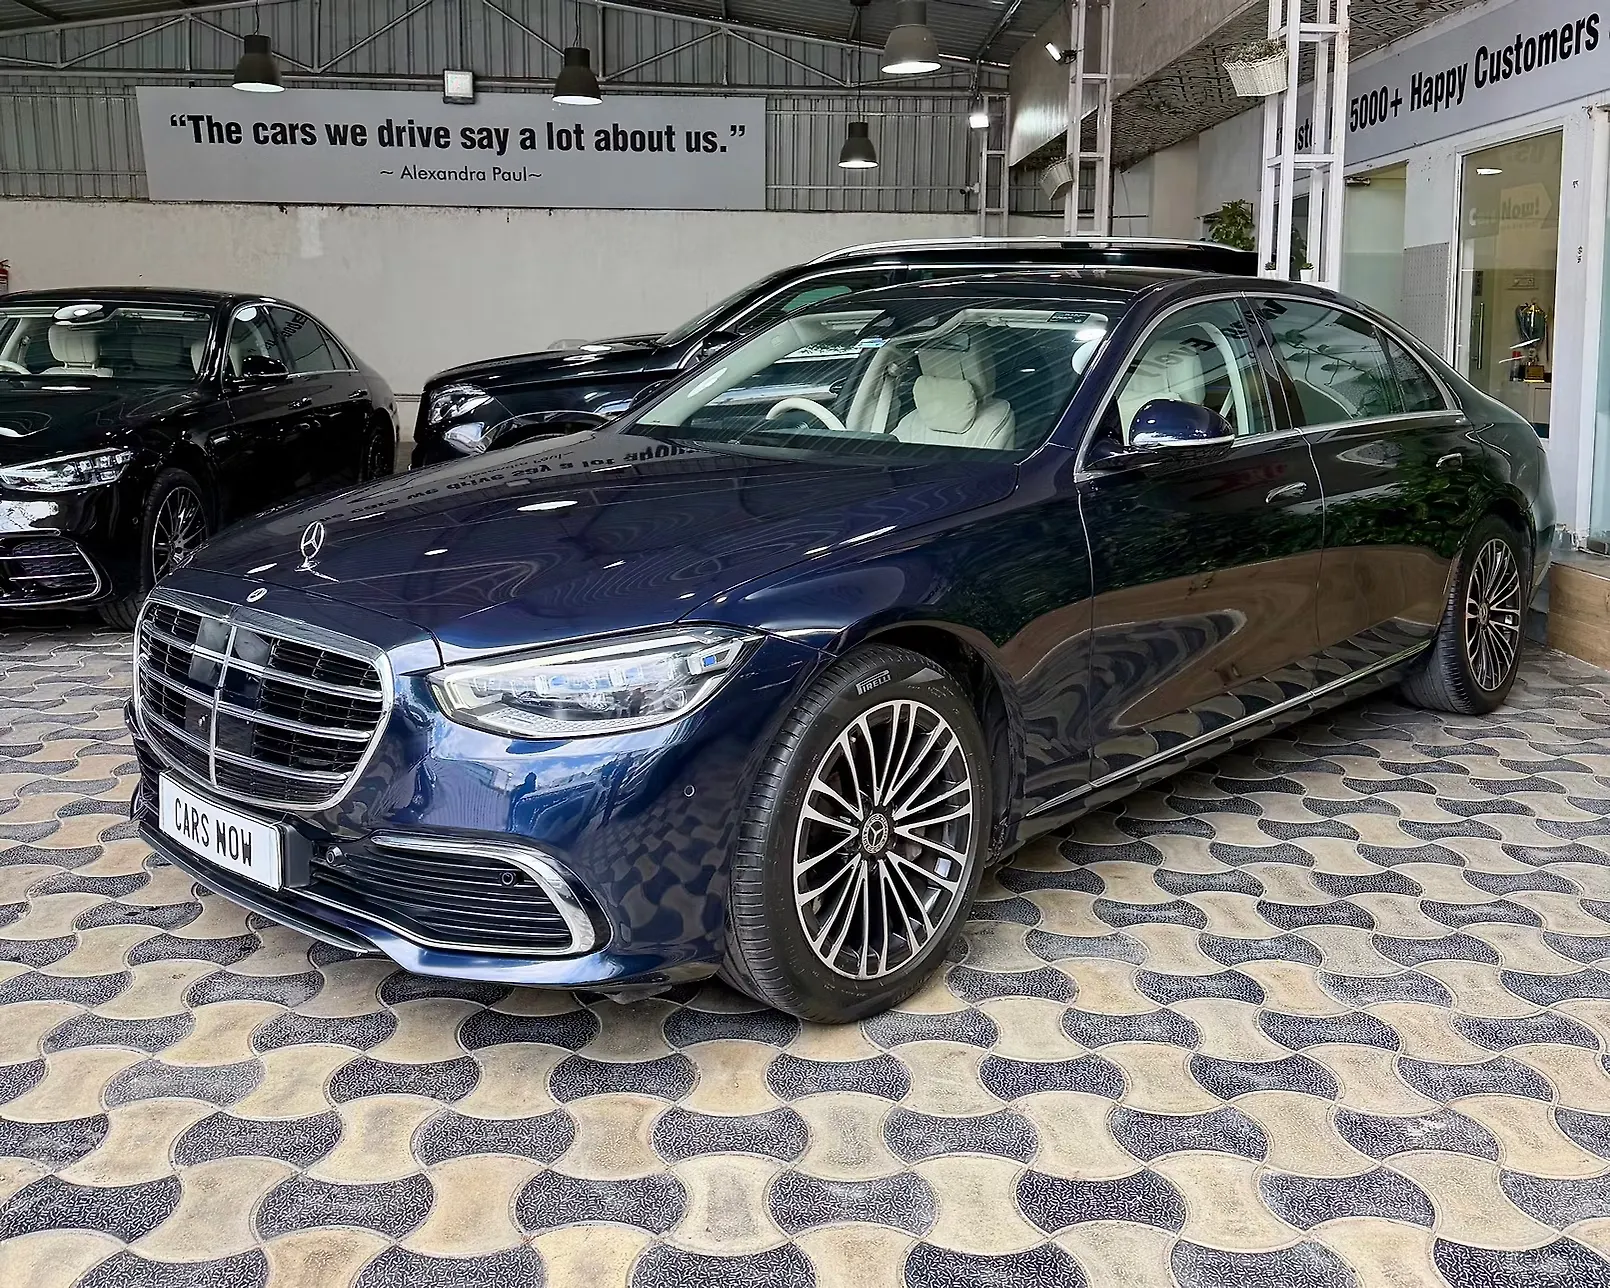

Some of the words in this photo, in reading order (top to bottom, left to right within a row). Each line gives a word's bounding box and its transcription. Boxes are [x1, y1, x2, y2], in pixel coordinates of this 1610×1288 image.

[1349, 85, 1402, 133] 5000+
[1409, 62, 1469, 112] Happy
[1474, 12, 1600, 89] Customers
[170, 114, 243, 145] “The
[252, 122, 317, 145] cars
[324, 123, 368, 147] we
[377, 118, 452, 149] drive
[460, 126, 510, 156] say
[519, 127, 537, 151] a
[546, 121, 586, 151] lot
[594, 122, 677, 153] about
[685, 124, 746, 153] us.”
[400, 164, 486, 182] Alexandra
[856, 670, 891, 696] PIRELLI
[175, 797, 210, 848] CARS
[216, 819, 252, 867] NOW
